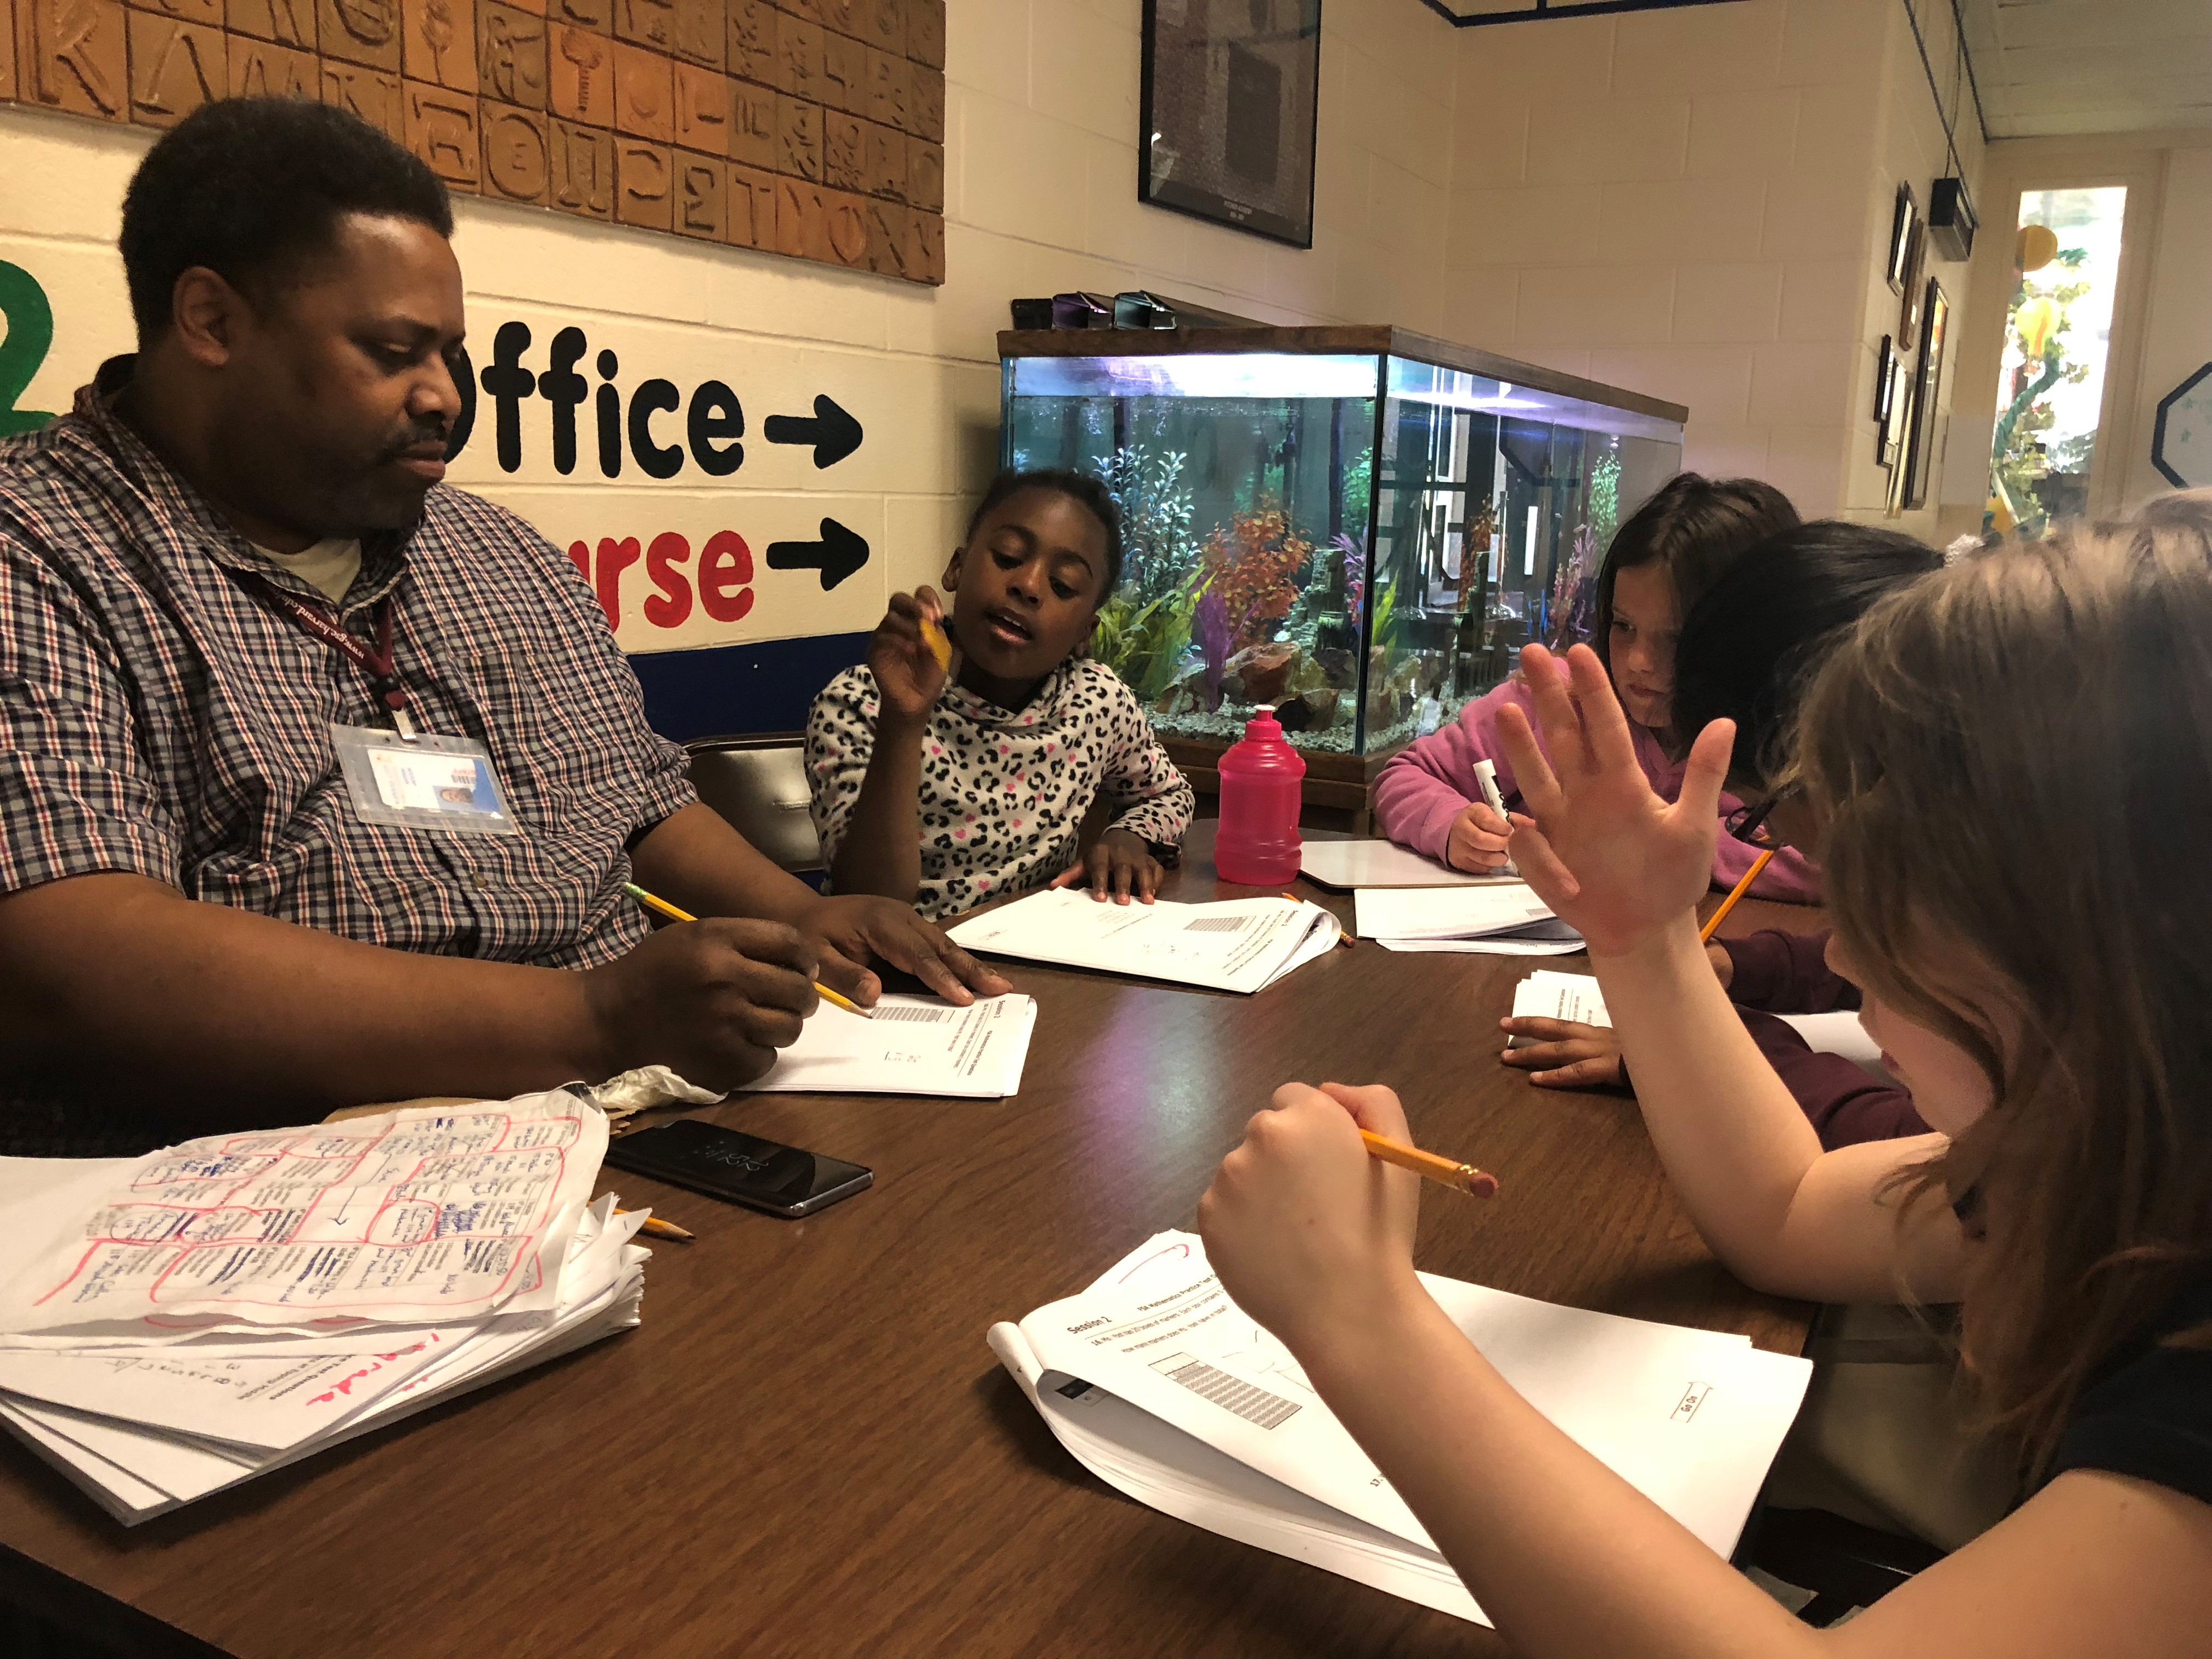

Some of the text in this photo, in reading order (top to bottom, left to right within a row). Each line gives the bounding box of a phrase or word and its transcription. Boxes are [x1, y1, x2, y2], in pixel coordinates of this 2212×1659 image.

[445, 321, 744, 479] ffice
[568, 530, 754, 634] rse
[1180, 1284, 1201, 1294] Practice
[1067, 1320, 1105, 1334] Session
[1680, 1395, 1698, 1412] Go On
[1370, 1479, 1384, 1487] 17.
